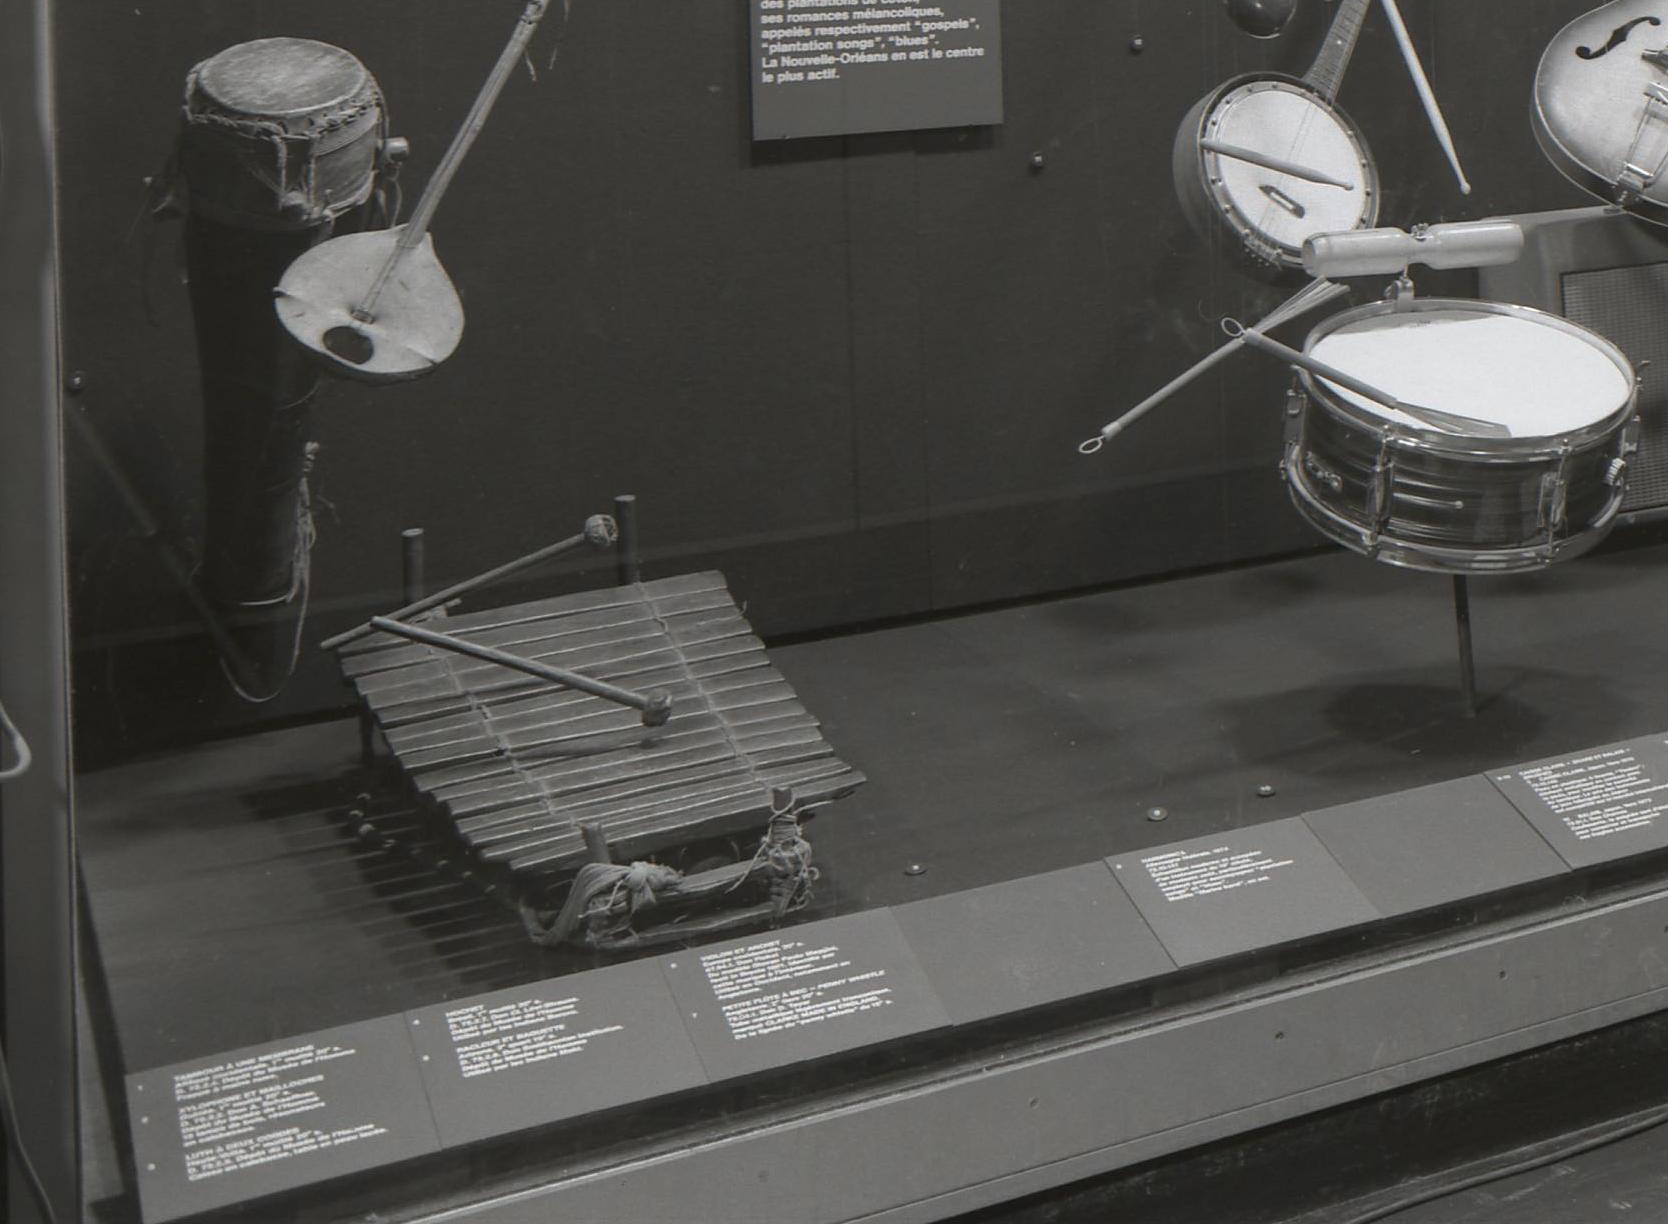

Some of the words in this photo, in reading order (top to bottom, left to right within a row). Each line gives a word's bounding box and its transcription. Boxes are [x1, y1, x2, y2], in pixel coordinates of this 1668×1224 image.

[760, 0, 783, 8] des
[760, 15, 783, 23] ses
[787, 12, 849, 22] romances
[762, 57, 777, 67] La
[781, 52, 888, 66] Nouvelle-Orléans
[891, 52, 906, 60] en
[909, 49, 928, 59] est
[931, 48, 943, 58] le
[945, 47, 983, 57] centre
[762, 72, 773, 82] le
[777, 71, 804, 83] plus
[807, 68, 839, 79] actif.
